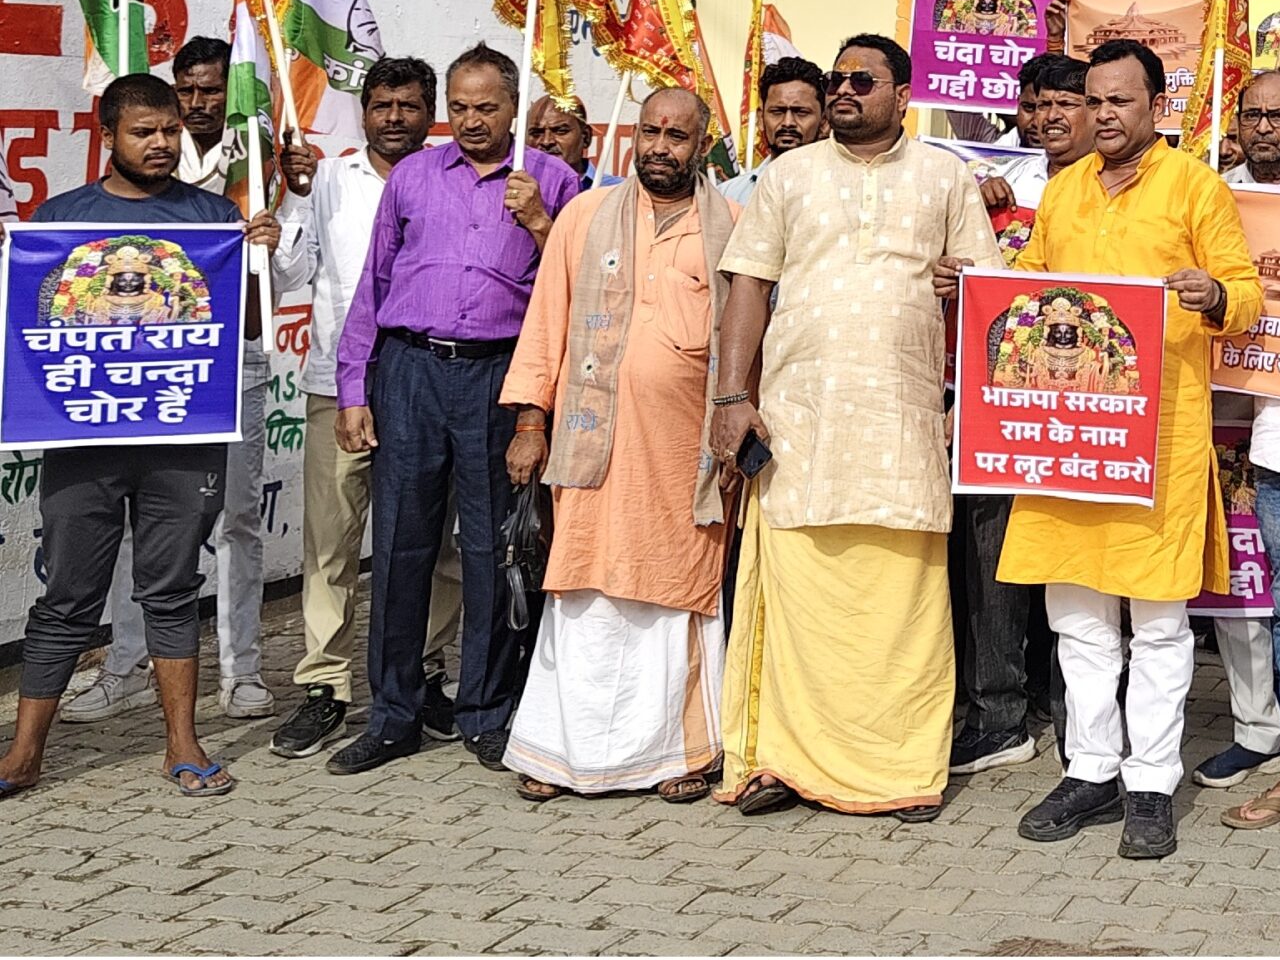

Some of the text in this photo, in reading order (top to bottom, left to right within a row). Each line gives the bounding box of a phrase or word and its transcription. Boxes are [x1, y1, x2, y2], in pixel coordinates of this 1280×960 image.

[934, 35, 985, 66] चंदा
[928, 69, 977, 100] गद्दी
[22, 321, 224, 352] चंपत राय
[1223, 341, 1241, 367] के
[1243, 346, 1275, 372] लिए
[43, 355, 213, 392] ही चन्दा
[64, 386, 192, 424] चोर हैं
[981, 386, 1148, 417] भाजपा सरकार
[1000, 417, 1128, 448] राम के नाम
[975, 452, 1151, 485] पर लूट बंद करो
[1228, 528, 1266, 555] दा
